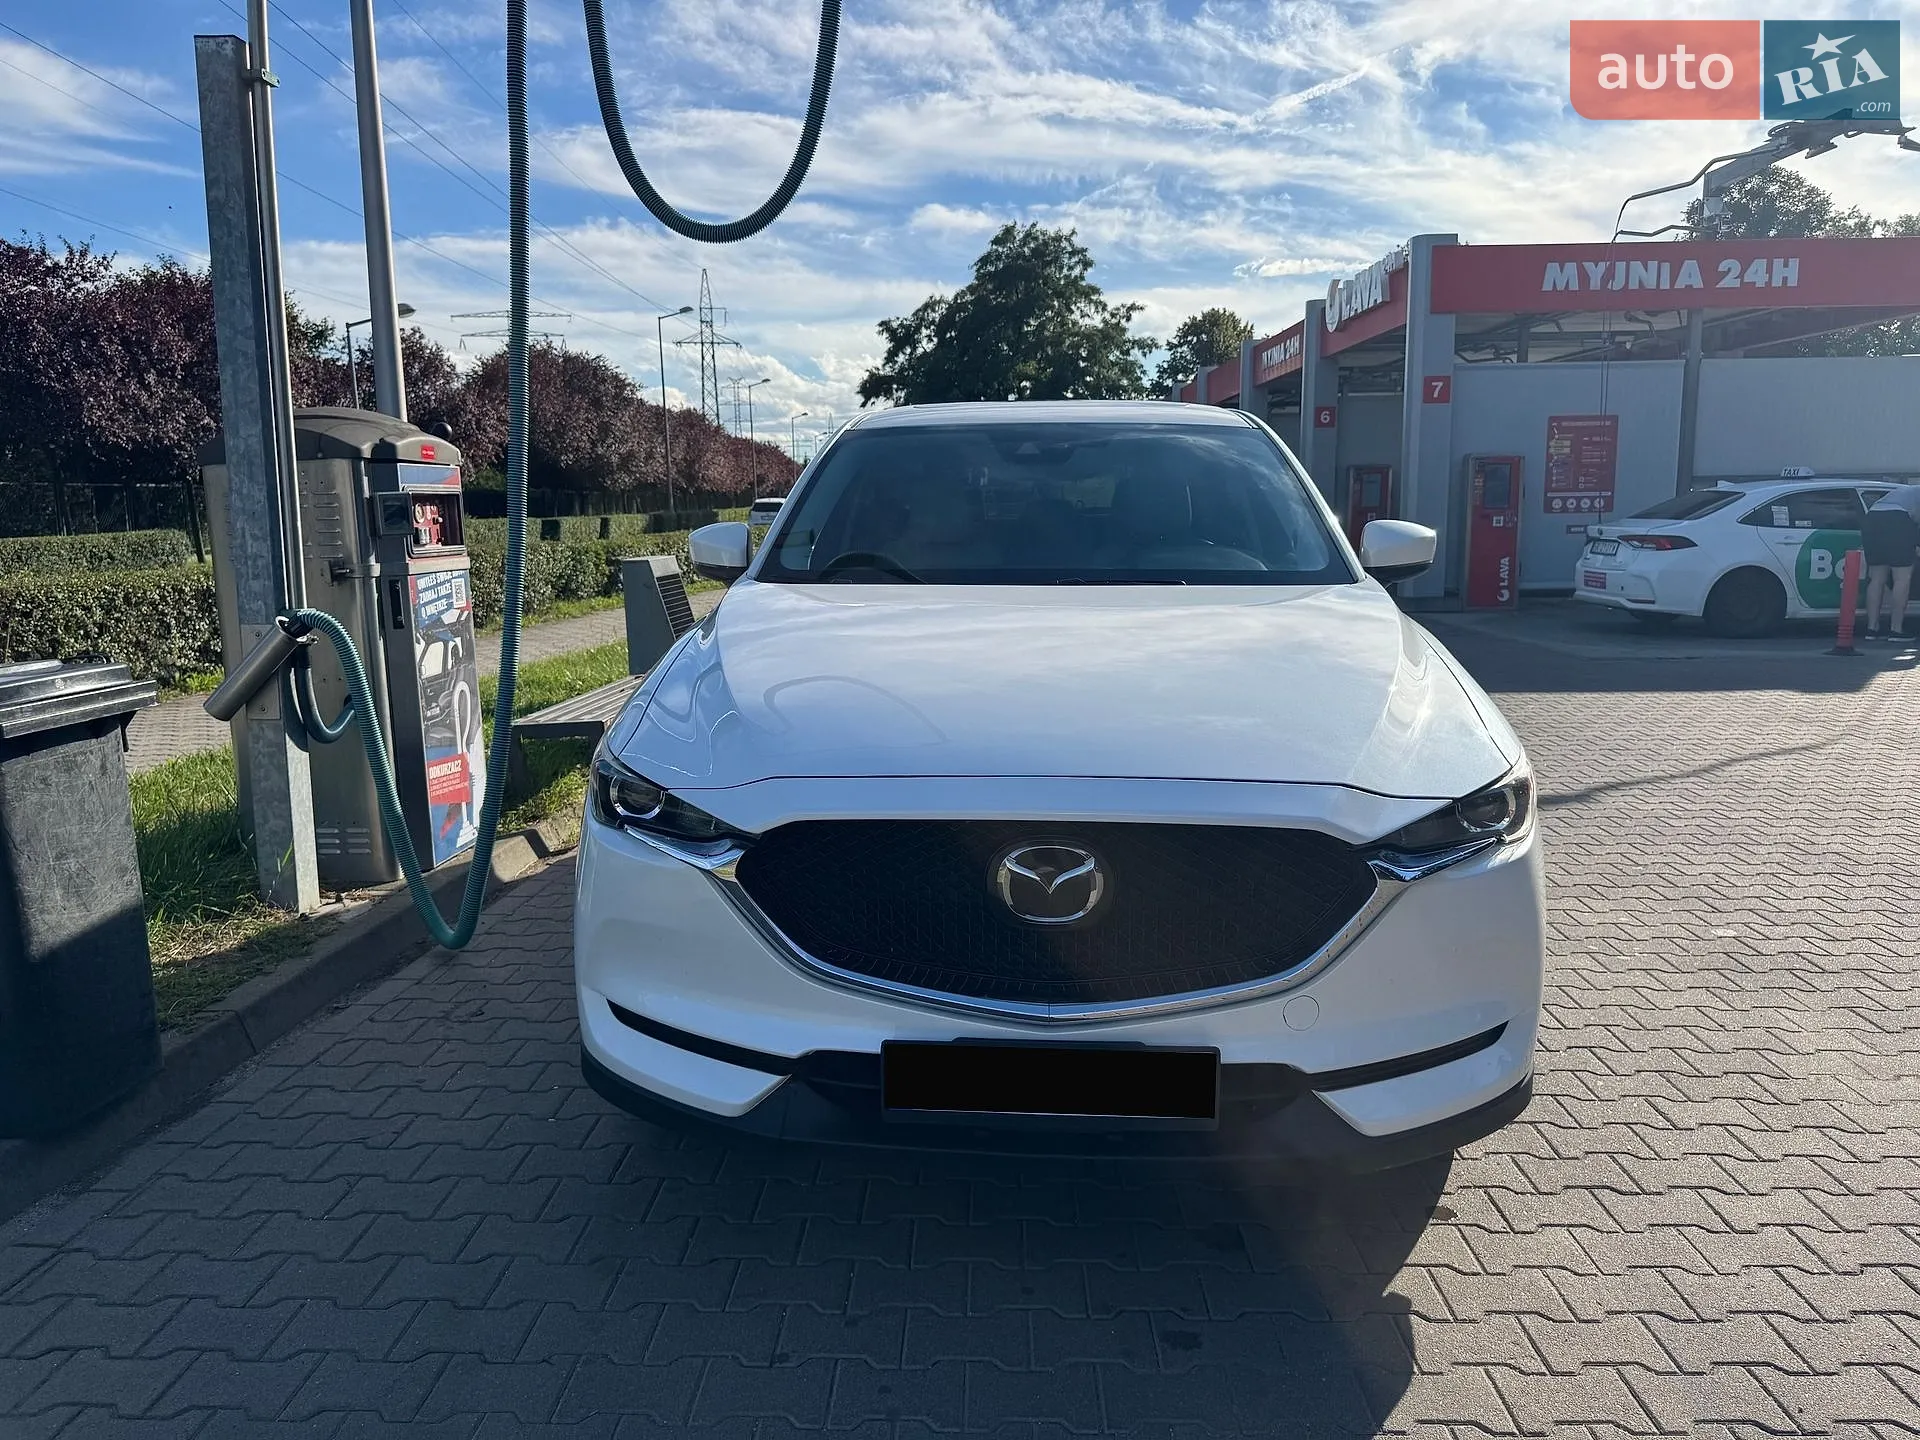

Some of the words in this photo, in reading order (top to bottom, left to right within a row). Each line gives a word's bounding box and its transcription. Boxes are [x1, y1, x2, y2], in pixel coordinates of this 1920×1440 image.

[1541, 259, 1704, 291] MYJNIA
[1716, 257, 1800, 288] 24H
[1341, 261, 1383, 321] LAVA
[1285, 333, 1300, 361] 24H
[1431, 381, 1444, 398] 7
[1320, 410, 1330, 423] 6
[1783, 468, 1800, 476] TAXI
[1499, 556, 1510, 586] LAVA
